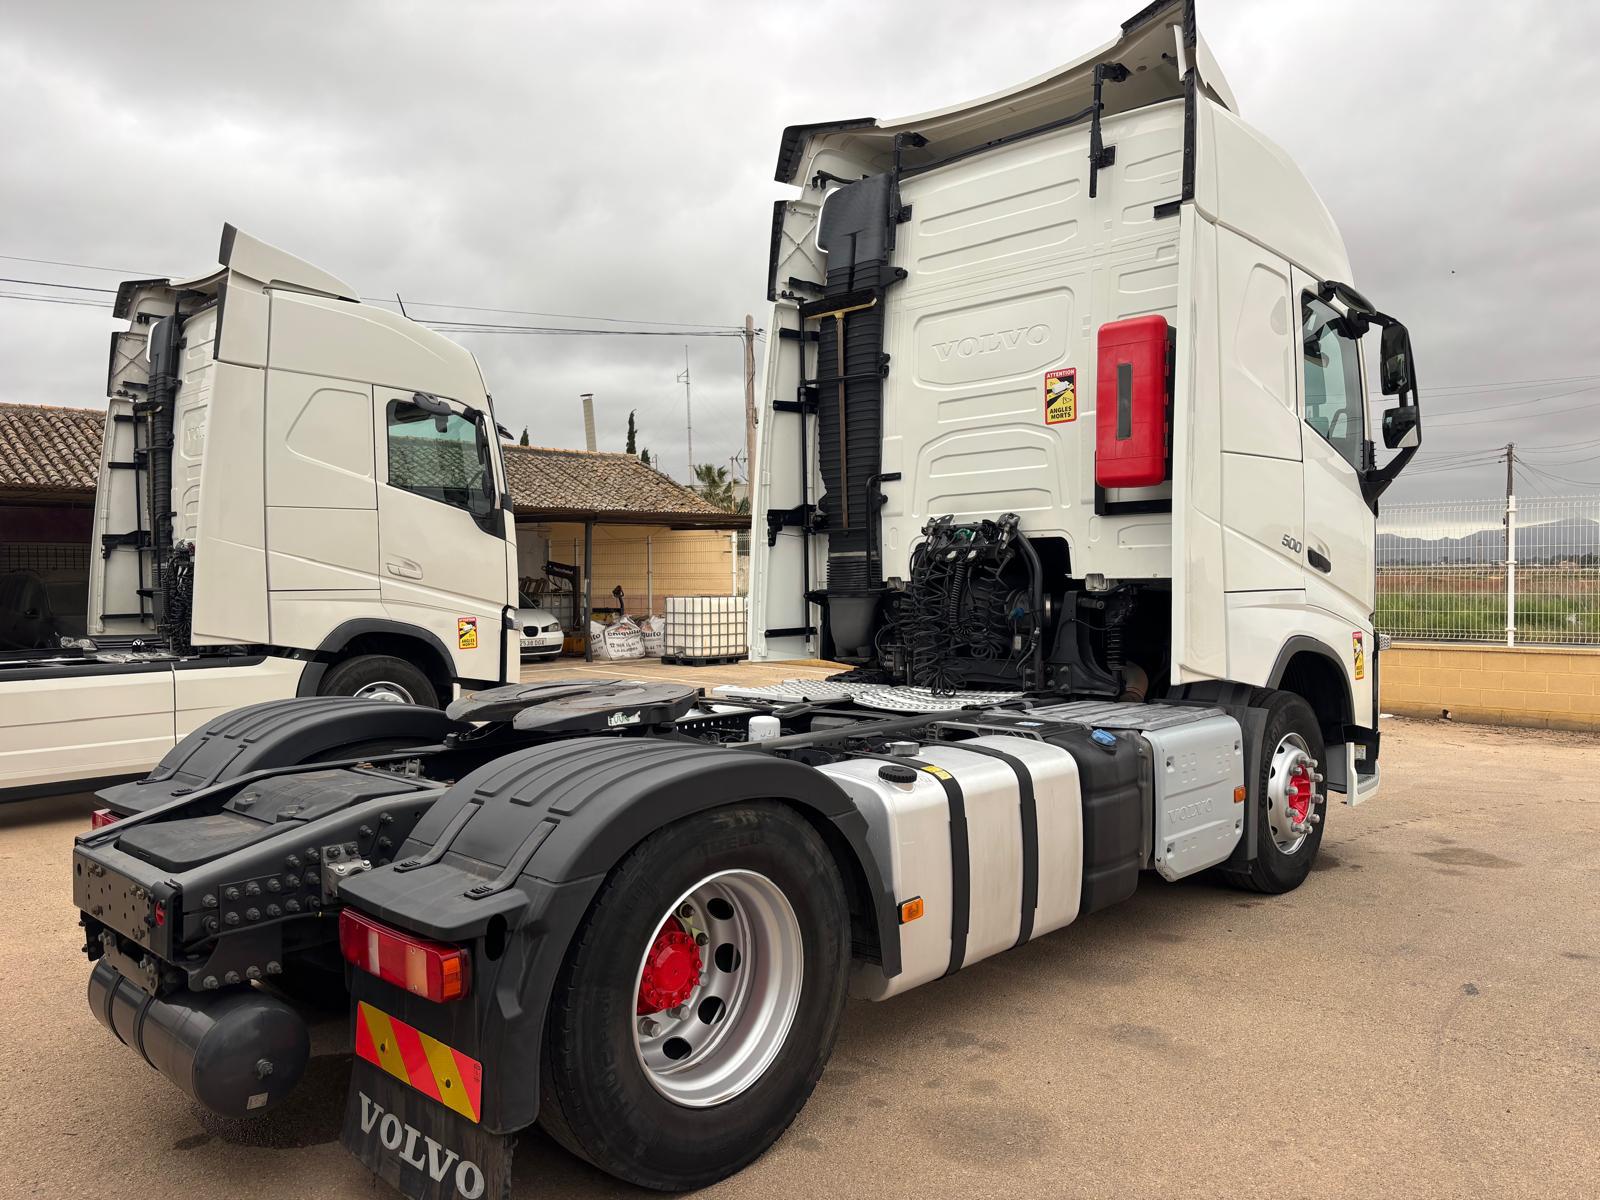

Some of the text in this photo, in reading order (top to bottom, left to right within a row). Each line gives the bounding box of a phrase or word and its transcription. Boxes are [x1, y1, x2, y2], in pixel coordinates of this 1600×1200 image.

[931, 323, 1051, 362] VOLVO
[1046, 368, 1075, 379] ATTENTION
[1049, 405, 1072, 415] ANGLES
[1050, 411, 1072, 420] MORTS
[1281, 533, 1303, 554] 500
[1167, 797, 1213, 825] VOLVO
[358, 1090, 485, 1200] VOLVO
